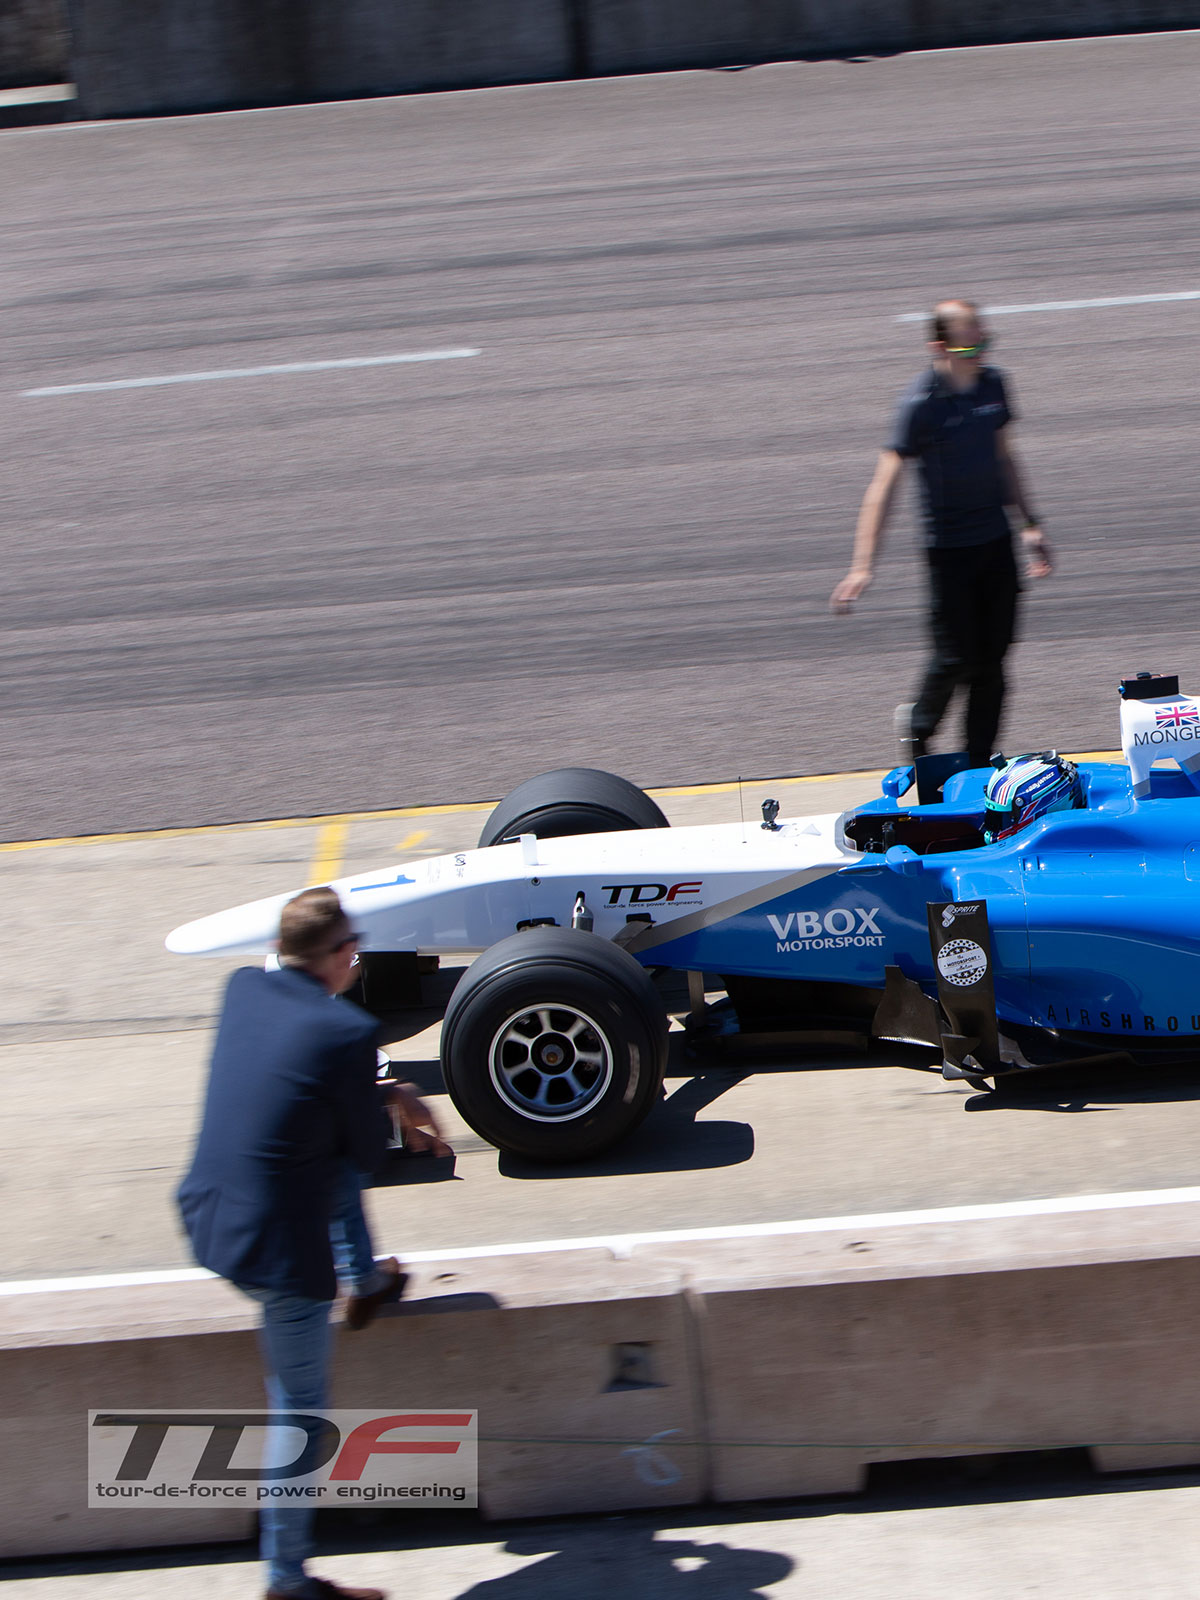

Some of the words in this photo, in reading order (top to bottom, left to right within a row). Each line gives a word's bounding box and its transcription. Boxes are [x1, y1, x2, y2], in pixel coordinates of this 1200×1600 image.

[601, 881, 703, 904] TDF
[952, 905, 980, 914] SPRITE
[766, 907, 882, 940] VBOX
[776, 935, 886, 953] MOTORSPORT
[946, 955, 977, 967] MOTORSPORT
